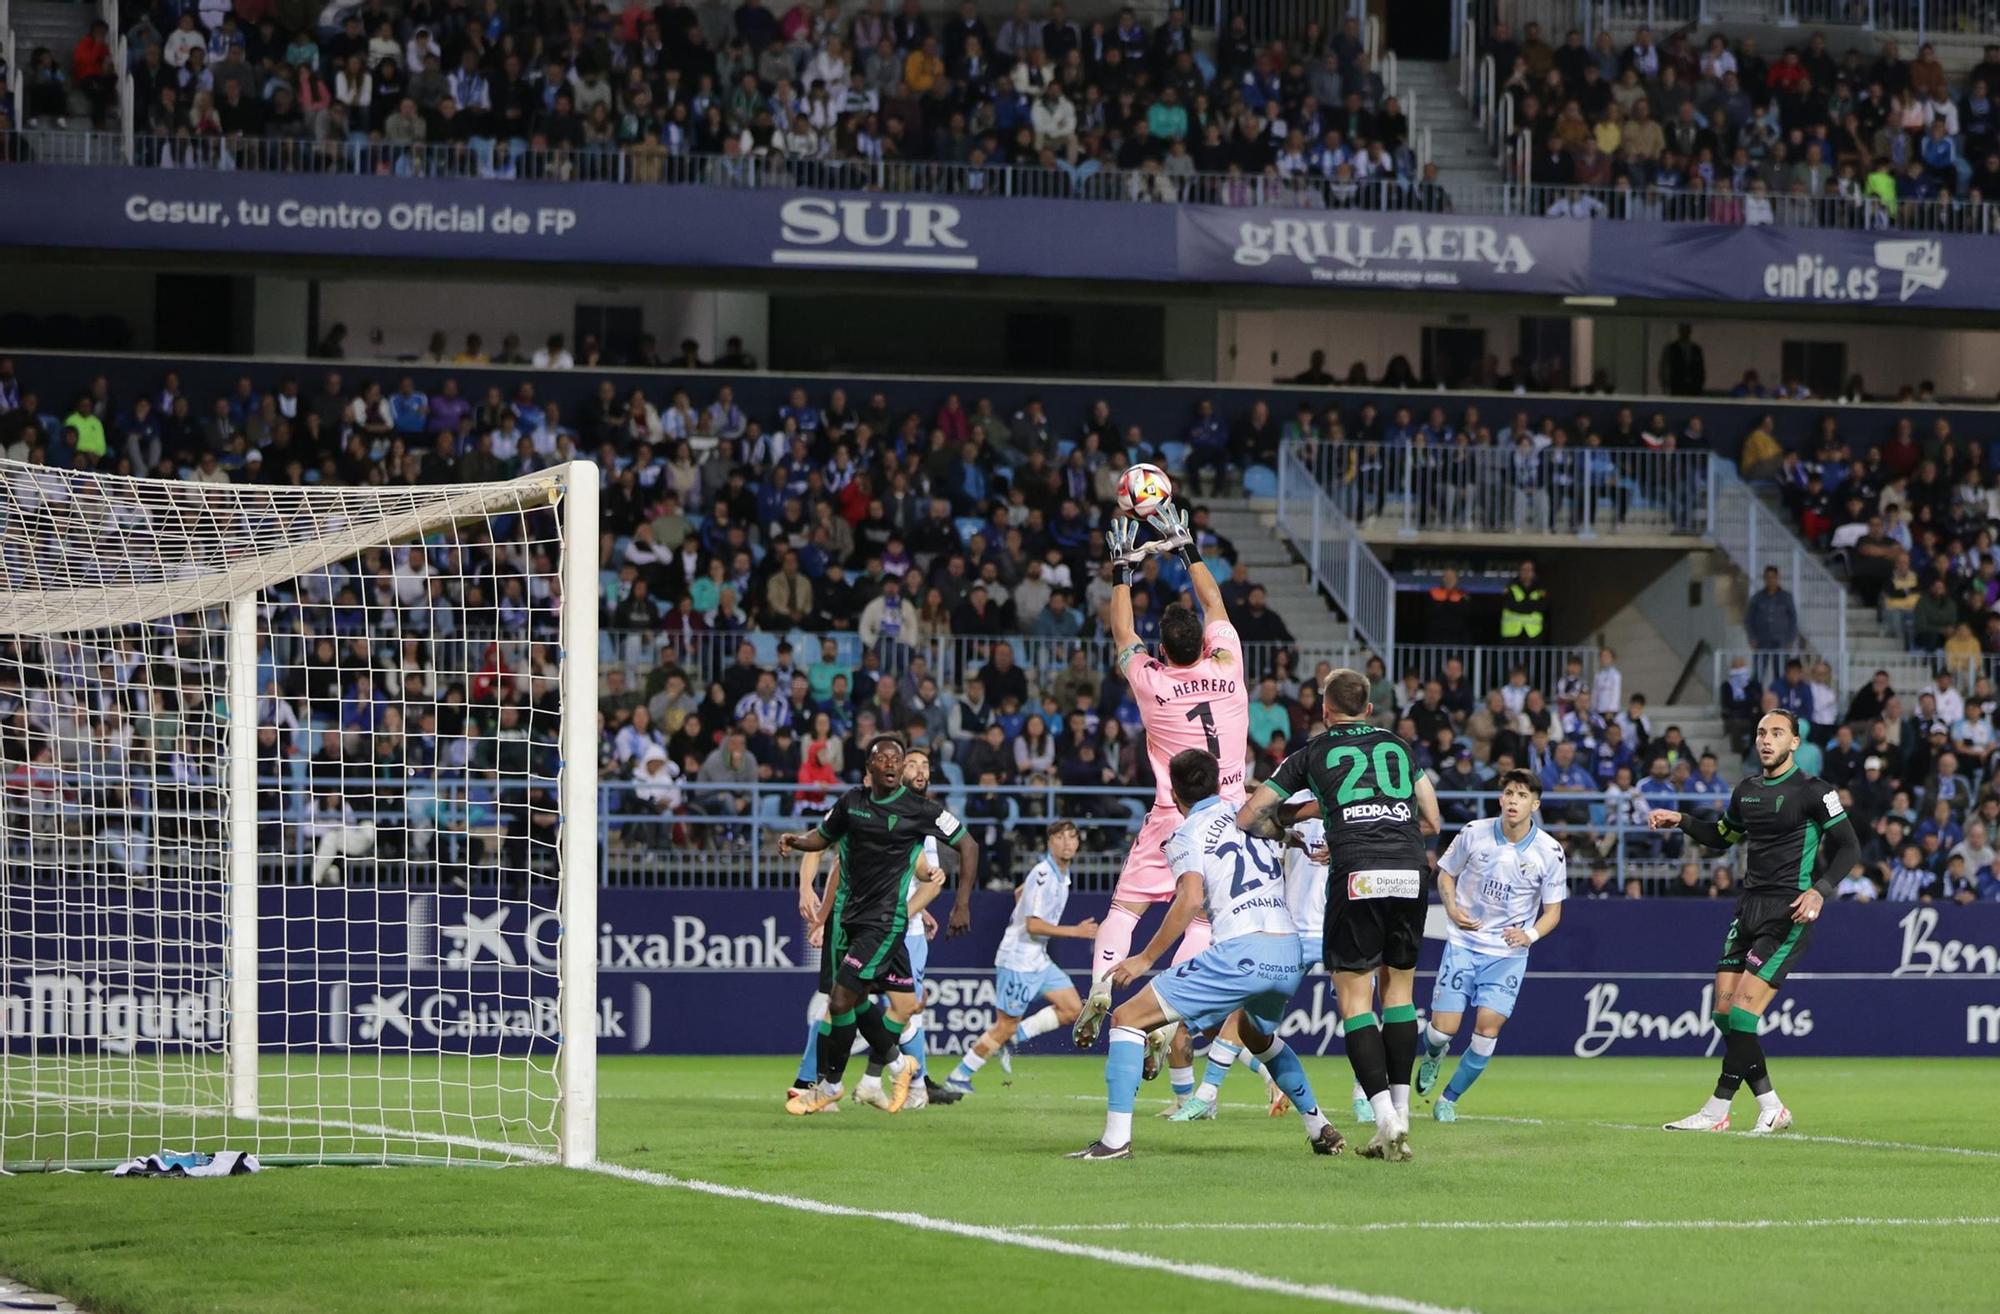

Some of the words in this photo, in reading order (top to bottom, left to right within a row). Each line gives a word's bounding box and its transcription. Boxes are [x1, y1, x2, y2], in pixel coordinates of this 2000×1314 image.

[125, 195, 230, 227] Cesur,
[238, 199, 270, 226] tu
[277, 200, 382, 230] Centro
[388, 202, 485, 233] Oficial
[490, 204, 531, 234] de
[537, 208, 577, 236] FP
[780, 197, 969, 248] SUR
[1763, 253, 1879, 300] enPie.es
[1155, 694, 1171, 707] A.
[1173, 679, 1236, 698] HERRERO
[1185, 701, 1221, 760] 1
[1326, 741, 1413, 806] 20
[1204, 813, 1234, 855] NELSON
[524, 911, 795, 970] CixaBank
[1891, 907, 2000, 977] Ben
[1259, 962, 1283, 973] COSTA
[25, 974, 222, 1055] Miguel
[419, 993, 627, 1038] CaixaBk
[922, 979, 997, 1007] OSTA
[947, 1008, 998, 1032] SOL
